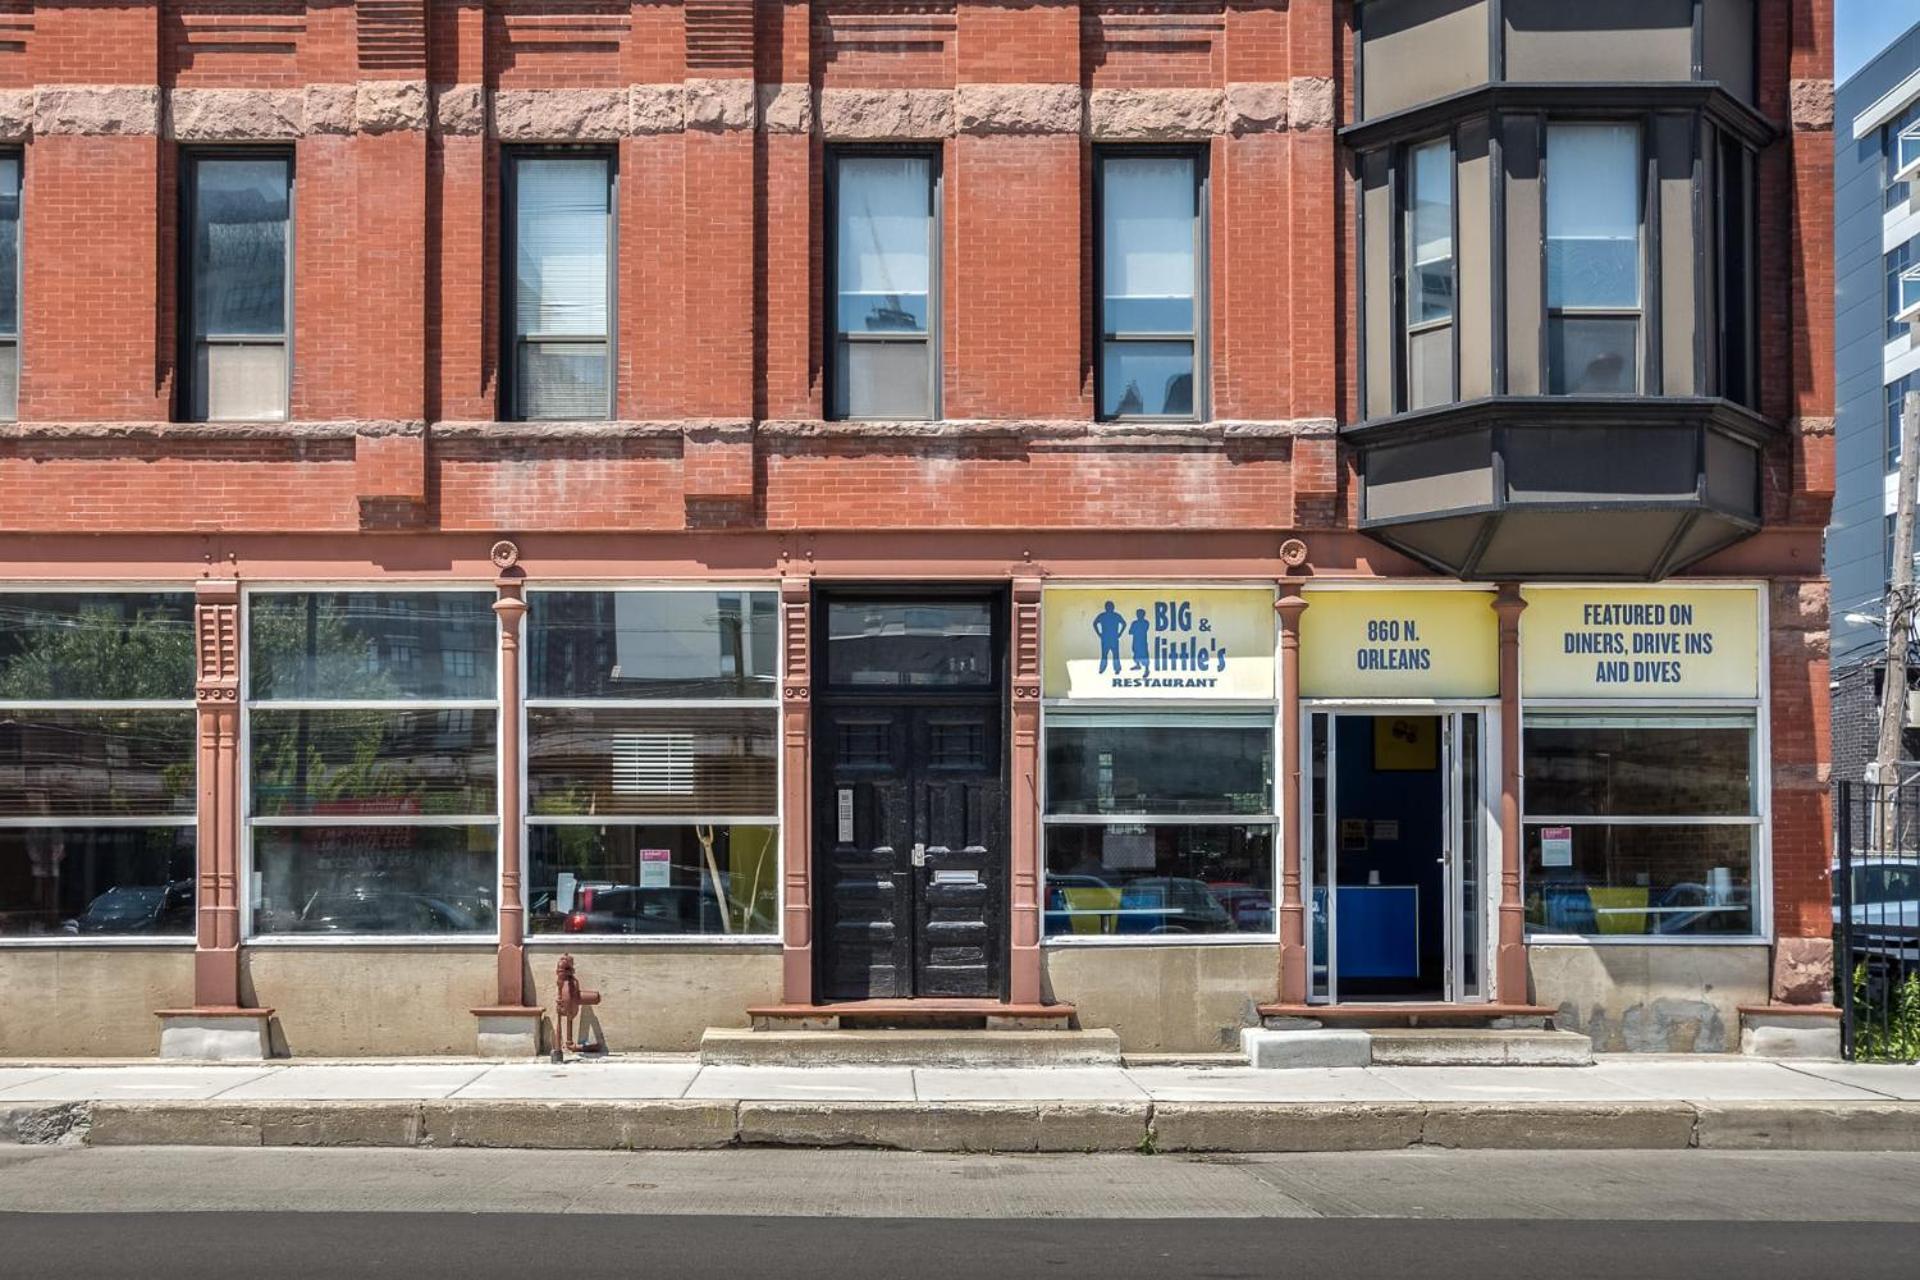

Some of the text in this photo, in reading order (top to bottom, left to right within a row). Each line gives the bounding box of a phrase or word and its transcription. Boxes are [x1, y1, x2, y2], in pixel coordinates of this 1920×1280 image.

[1154, 601, 1212, 632] BIG &
[1584, 604, 1692, 625] FEATURED ON
[1368, 620, 1419, 641] 860 N.
[1154, 636, 1226, 672] little's
[1564, 632, 1713, 655] DINERS, DRIVE INS
[1357, 648, 1430, 670] ORLEANS
[1112, 678, 1218, 688] RESTAURANT
[1596, 661, 1681, 683] AND DIVES
